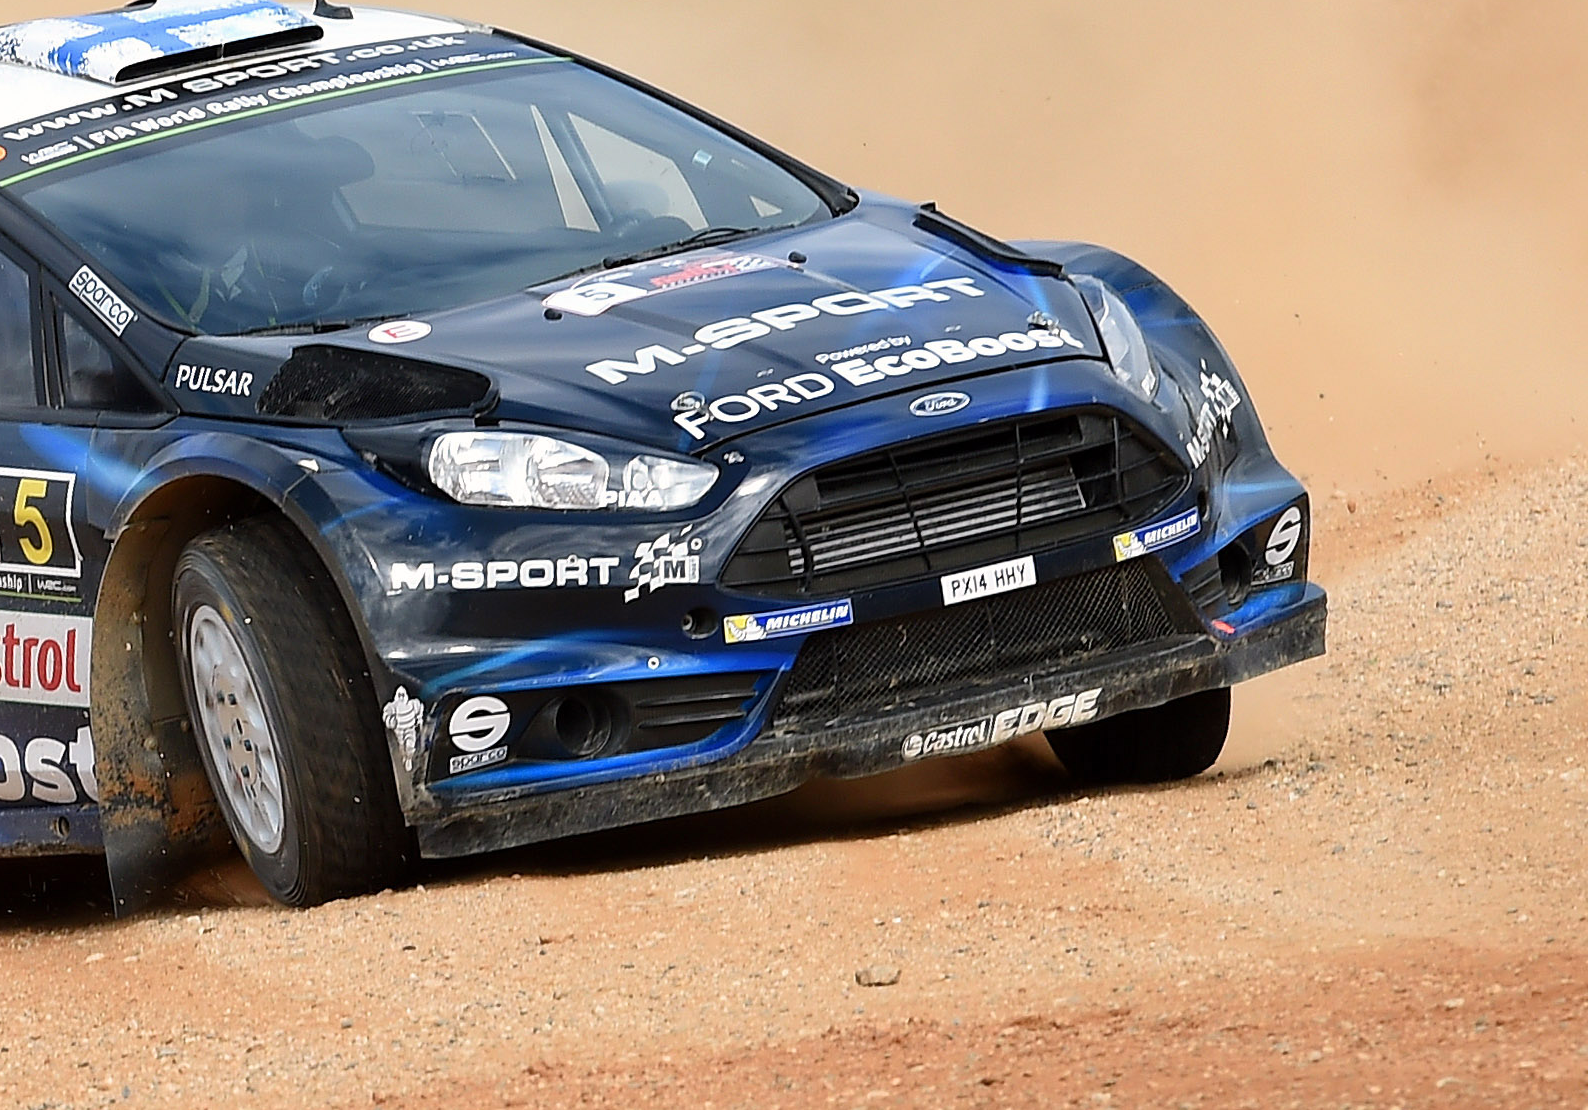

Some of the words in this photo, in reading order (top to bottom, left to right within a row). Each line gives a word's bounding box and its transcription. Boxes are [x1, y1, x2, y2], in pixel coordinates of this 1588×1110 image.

[89, 126, 137, 145] FIA
[131, 106, 207, 133] World
[206, 93, 269, 115] Rally
[267, 61, 425, 100] Championship
[75, 270, 131, 327] sparco
[585, 277, 985, 385] M-SPORT
[815, 339, 890, 364] Powered
[175, 364, 254, 396] PULSAR
[673, 373, 835, 441] FORD
[601, 490, 663, 507] PIAA
[14, 478, 53, 565] 5
[1144, 513, 1198, 546] MICHELIN
[389, 556, 620, 591] M-SPORT
[951, 573, 987, 598] PX14
[994, 563, 1025, 588] HHY
[765, 604, 849, 630] MICHELIN
[922, 721, 987, 755] Castrol
[991, 687, 1103, 743] EDGE
[450, 747, 508, 771] sparco
